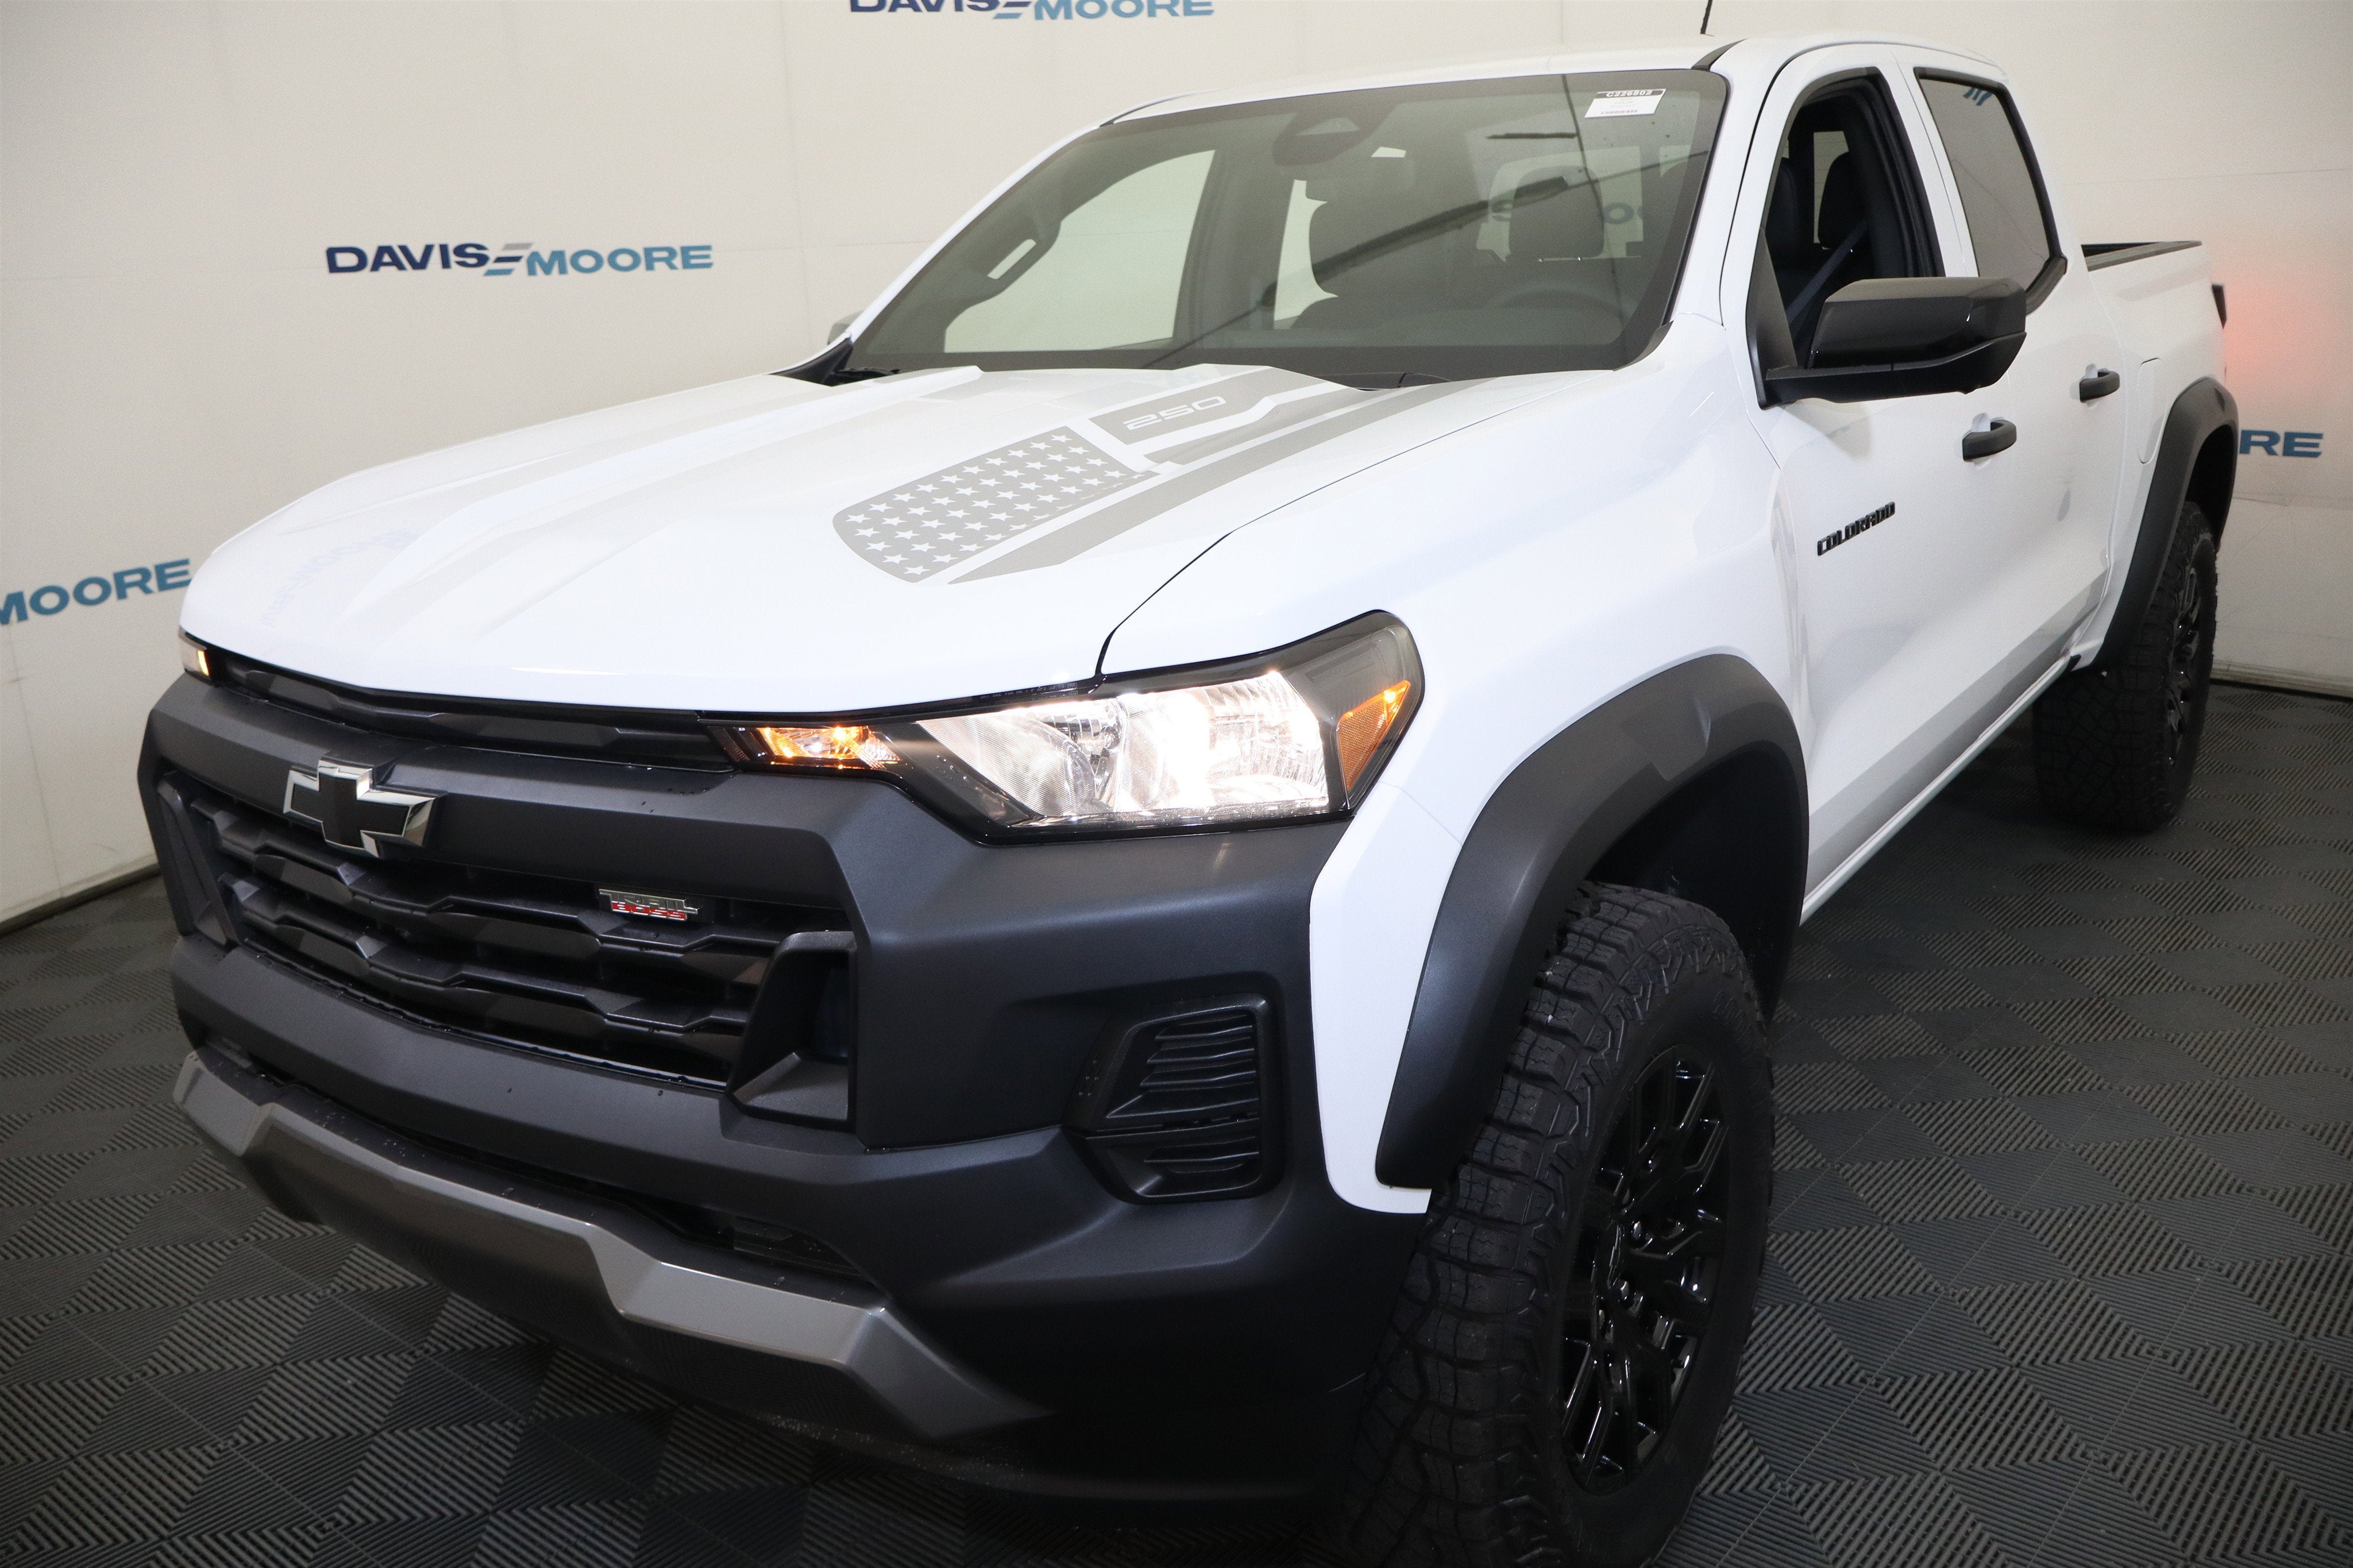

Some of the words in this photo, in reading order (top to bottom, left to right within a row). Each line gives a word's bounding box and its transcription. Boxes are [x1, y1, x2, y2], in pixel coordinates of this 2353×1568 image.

[1034, 0, 1215, 20] MOORE
[326, 242, 490, 273] DAVIS
[526, 245, 713, 276] MOORE
[1122, 396, 1227, 431] 250
[1817, 501, 1896, 557] COLORADO
[0, 558, 192, 625] MOORE
[611, 901, 688, 921] BOSS
